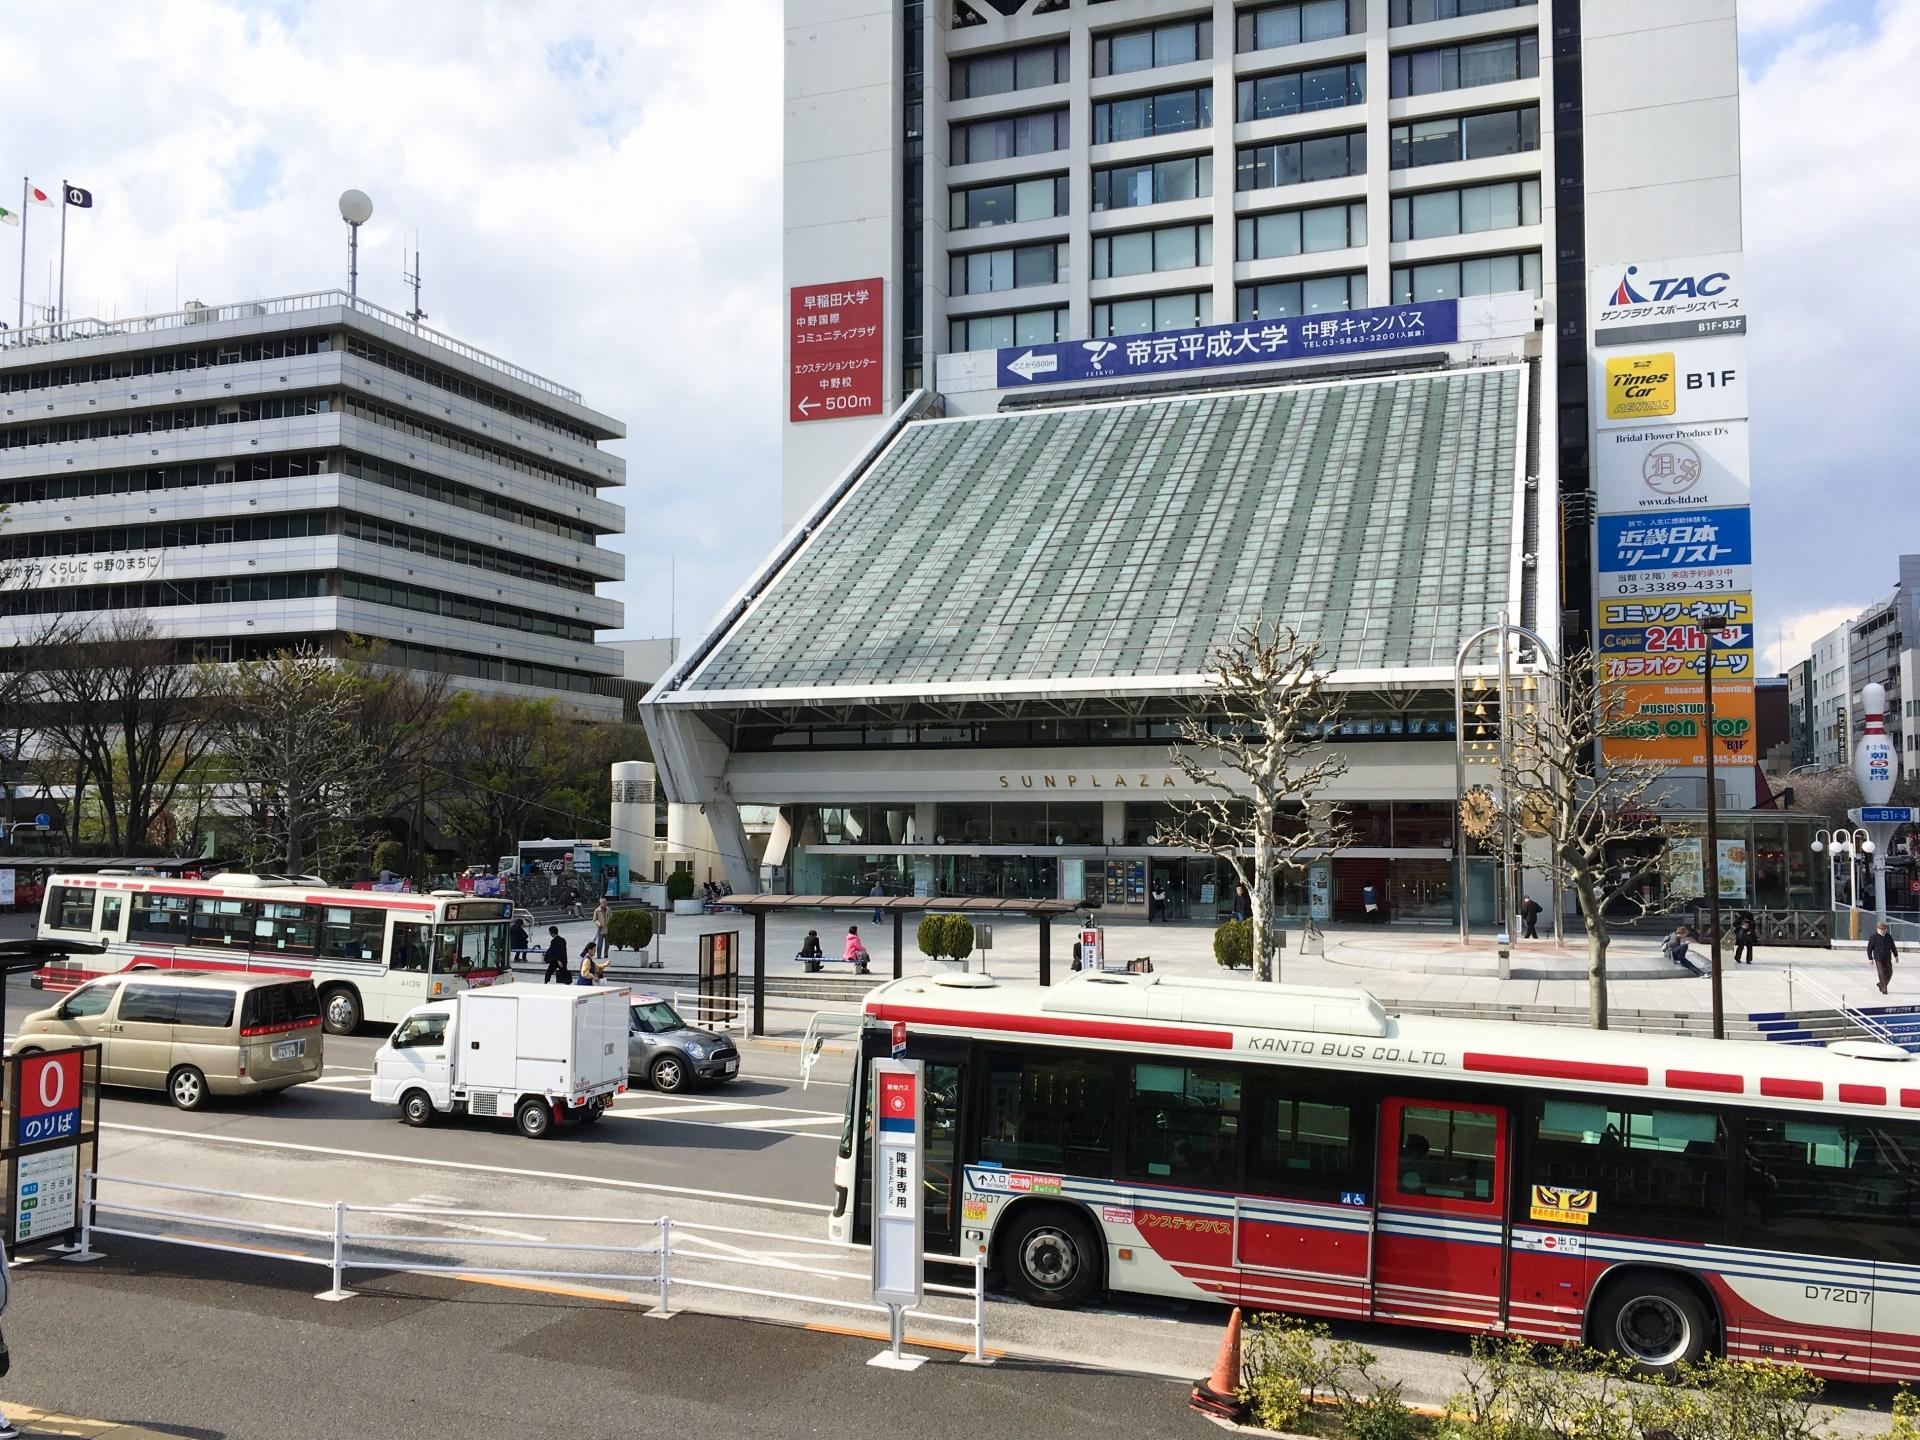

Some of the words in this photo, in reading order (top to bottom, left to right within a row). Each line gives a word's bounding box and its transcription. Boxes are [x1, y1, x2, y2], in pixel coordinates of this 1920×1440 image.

[1648, 272, 1730, 302] TAC
[803, 289, 869, 310] 早稲田大学
[1600, 307, 1653, 321] サンプラザ
[1653, 299, 1740, 317] スポーツスペース
[796, 312, 840, 328] 中野国際
[1302, 311, 1424, 340] 中野キャンパス
[797, 325, 877, 344] コミュニティプラザ
[1126, 324, 1288, 367] 帝京平成大学
[795, 358, 878, 374] エクステンションセンター
[1085, 369, 1114, 377] TEIKYO
[819, 376, 852, 390] 中野校
[1613, 373, 1669, 387] Times
[1686, 370, 1736, 389] B1F
[1625, 385, 1656, 398] Car
[825, 395, 872, 410] 500m
[1613, 400, 1669, 414] RENTAL
[1616, 434, 1643, 443] Bridal
[1645, 432, 1674, 441] Flower
[1676, 430, 1712, 439] Produce
[1714, 427, 1728, 435] D's
[1638, 495, 1708, 507] www.ds-ltd.net
[1617, 525, 1719, 548] 近畿日本
[1617, 545, 1732, 567] ツーリスト
[49, 562, 88, 575] くらしに
[93, 556, 157, 571] 中野のまちに
[1618, 579, 1733, 594] 03-3389-4331
[1607, 600, 1747, 623] コミック・ネット
[1640, 704, 1674, 714] MUSIC
[1676, 703, 1715, 714] STUD
[999, 774, 1176, 788] SUNPLAZA
[1248, 1036, 1315, 1054] KANTO
[1321, 1043, 1366, 1058] BUS
[39, 1060, 64, 1108] 0
[26, 1112, 73, 1137] のりば
[896, 1151, 907, 1208] 降車専用
[989, 1174, 1006, 1183] 入口
[1033, 1177, 1059, 1185] PASMO
[964, 1192, 1001, 1204] D7207
[1138, 1213, 1232, 1235] ノンステップバス
[1557, 1236, 1577, 1247] 出口
[1805, 1285, 1871, 1304] D7207
